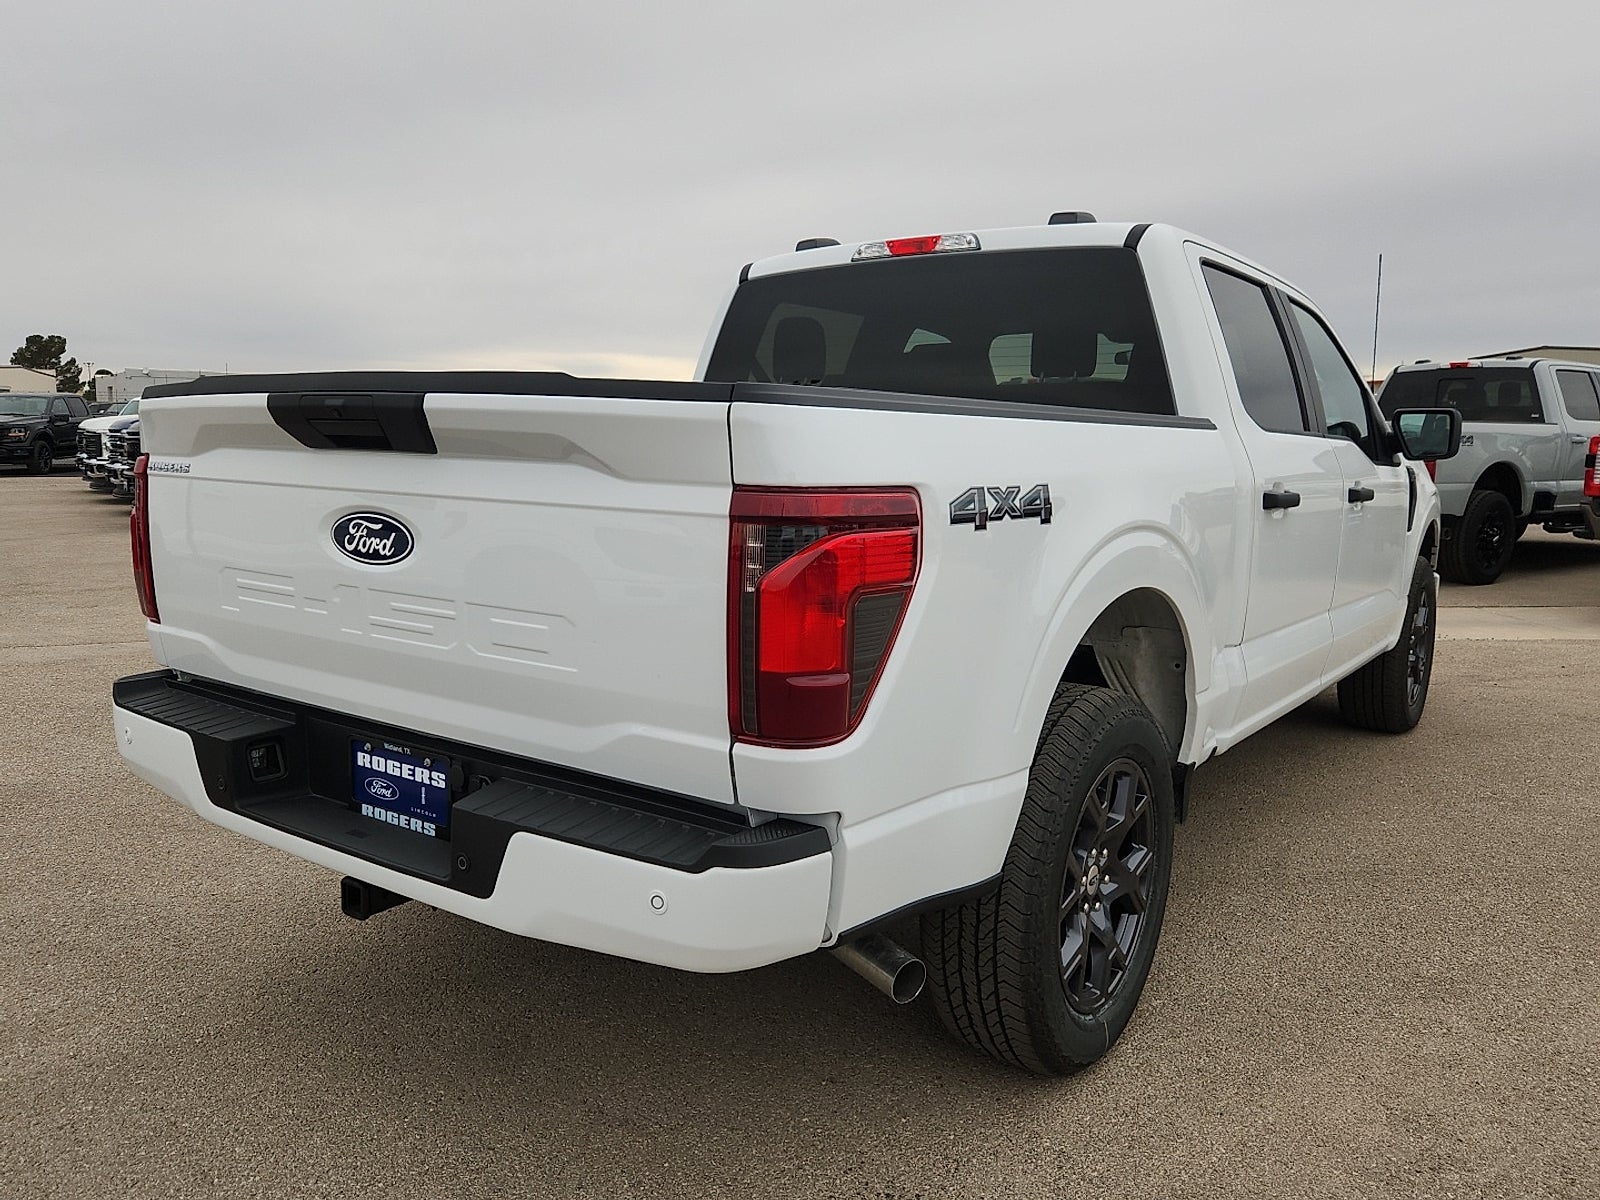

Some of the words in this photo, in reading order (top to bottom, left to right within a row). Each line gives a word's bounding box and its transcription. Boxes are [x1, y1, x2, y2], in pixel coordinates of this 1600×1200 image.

[344, 519, 396, 556] Ford
[219, 566, 578, 672] F-150
[357, 751, 446, 789] ROGERS
[370, 779, 393, 798] Ford
[361, 803, 436, 837] ROGERS
[410, 806, 437, 818] LINCOLN
